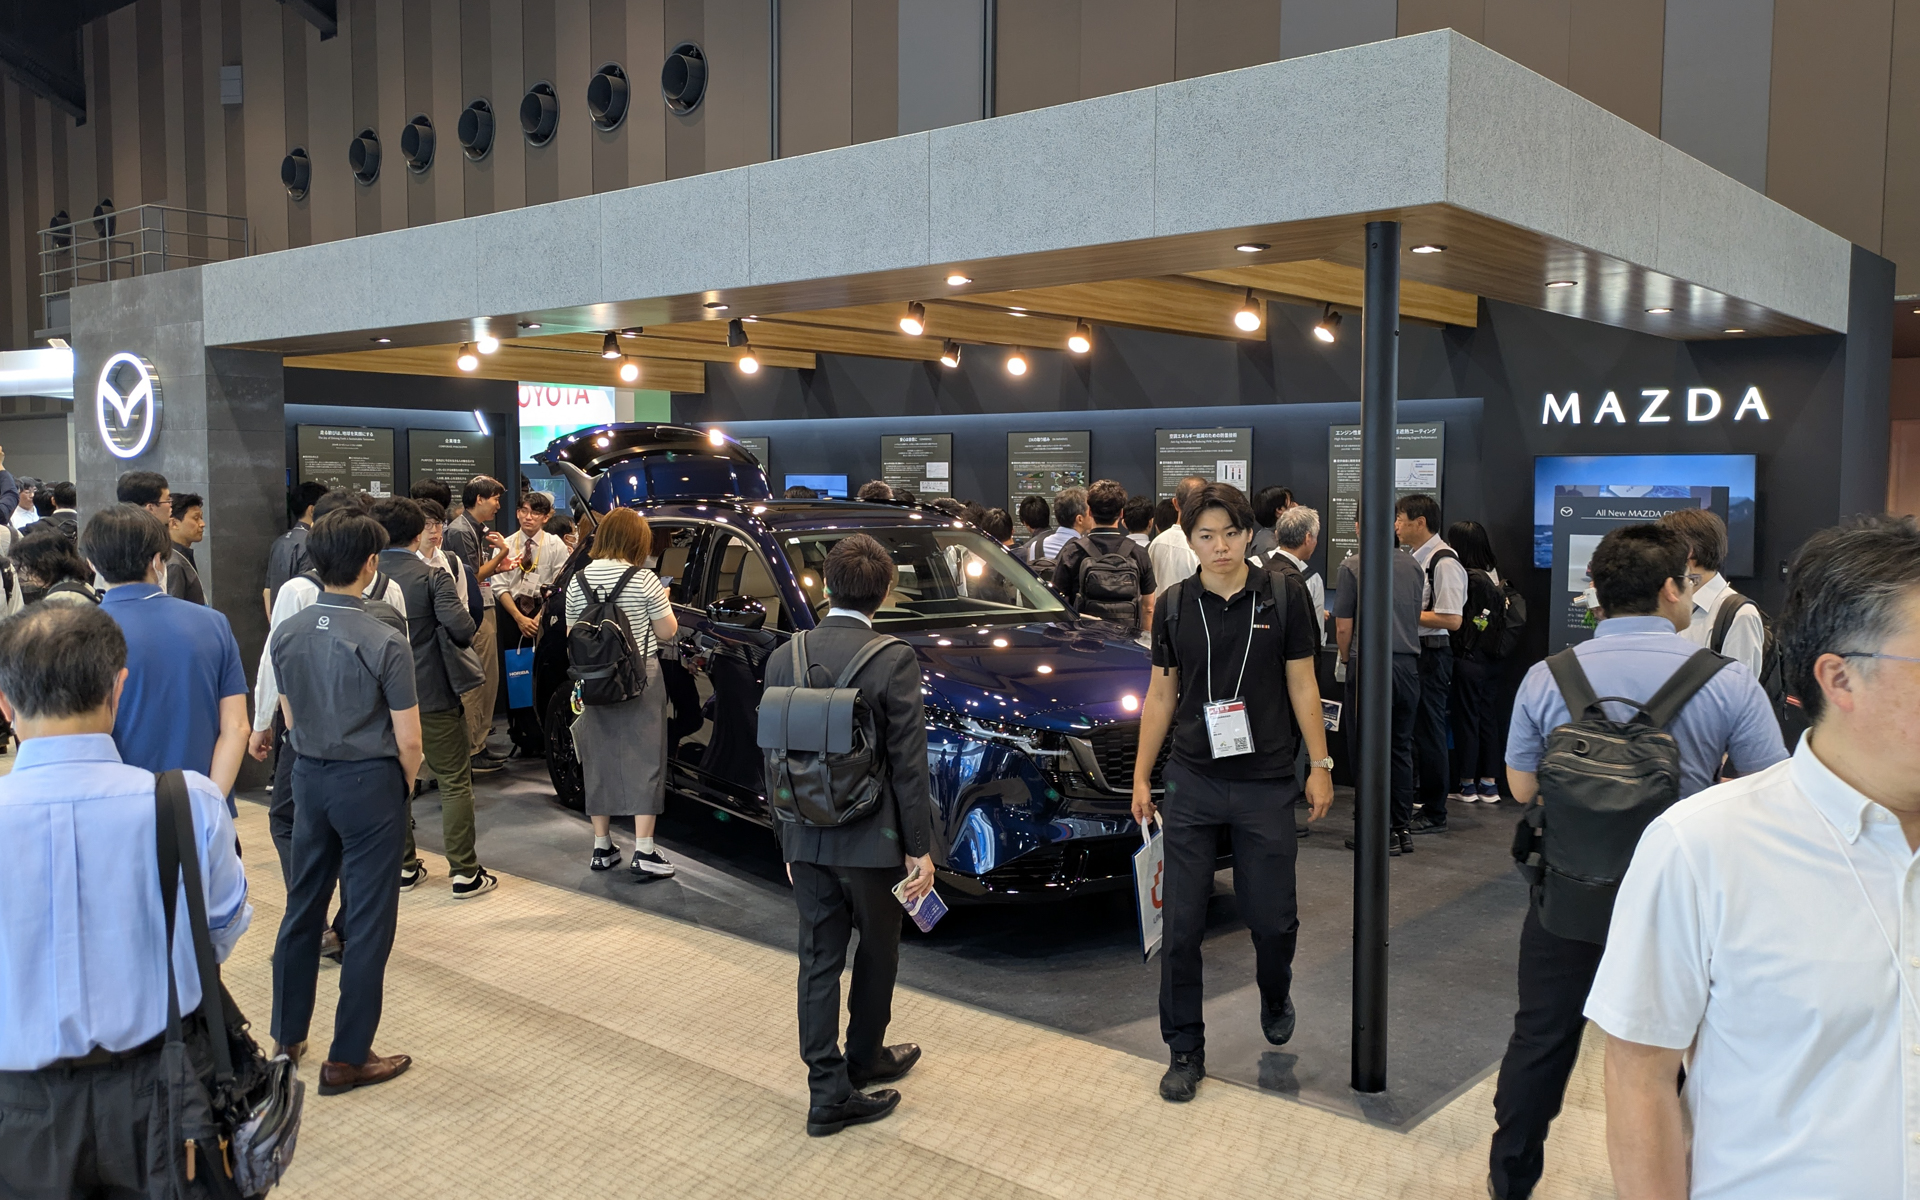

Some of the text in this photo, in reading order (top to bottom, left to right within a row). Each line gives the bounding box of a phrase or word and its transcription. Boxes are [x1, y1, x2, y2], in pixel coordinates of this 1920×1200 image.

[518, 386, 590, 408] OYOTA
[1542, 386, 1770, 424] MAZDA
[1595, 509, 1606, 517] All
[1608, 509, 1627, 517] New
[1628, 510, 1662, 518] MAZDA
